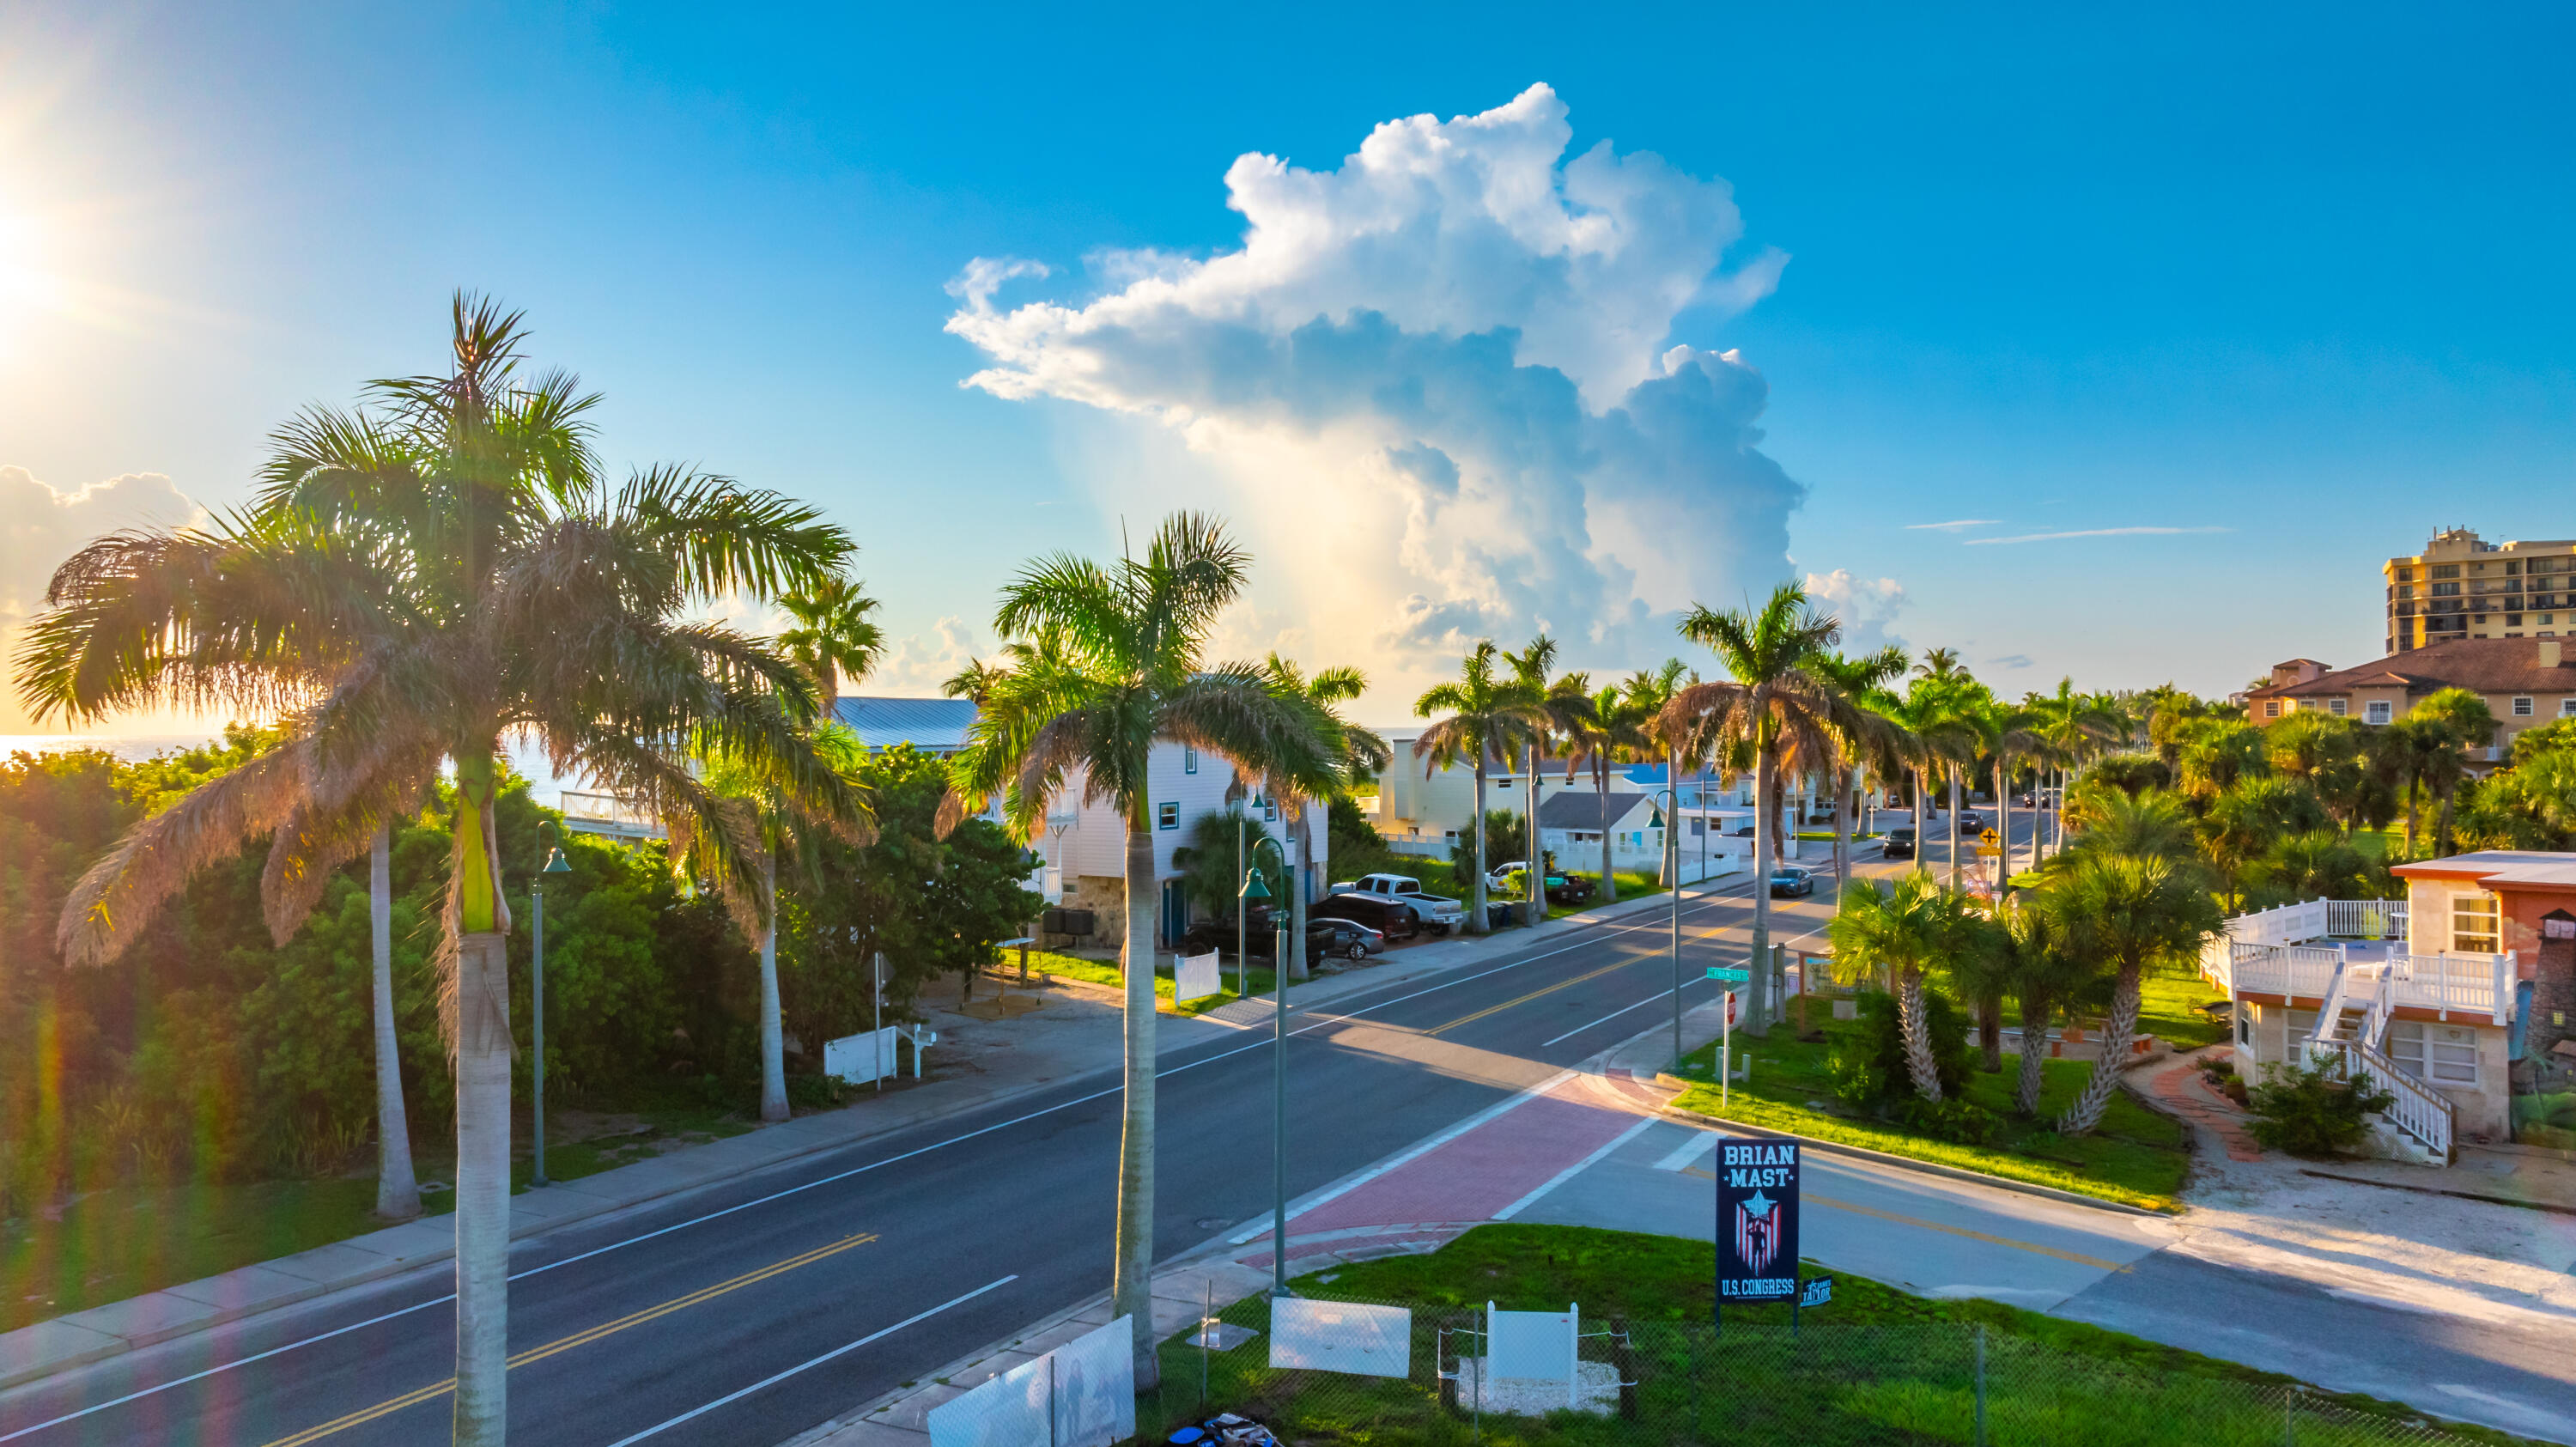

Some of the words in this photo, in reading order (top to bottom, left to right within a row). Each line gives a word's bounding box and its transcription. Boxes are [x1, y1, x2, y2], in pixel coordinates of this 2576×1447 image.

[1724, 1146, 1795, 1165] BRIAN
[1730, 1169, 1789, 1188] MAST
[1722, 1280, 1741, 1296] U.S.
[1741, 1279, 1795, 1295] CONGRESS
[1802, 1286, 1831, 1303] TAYLOR
